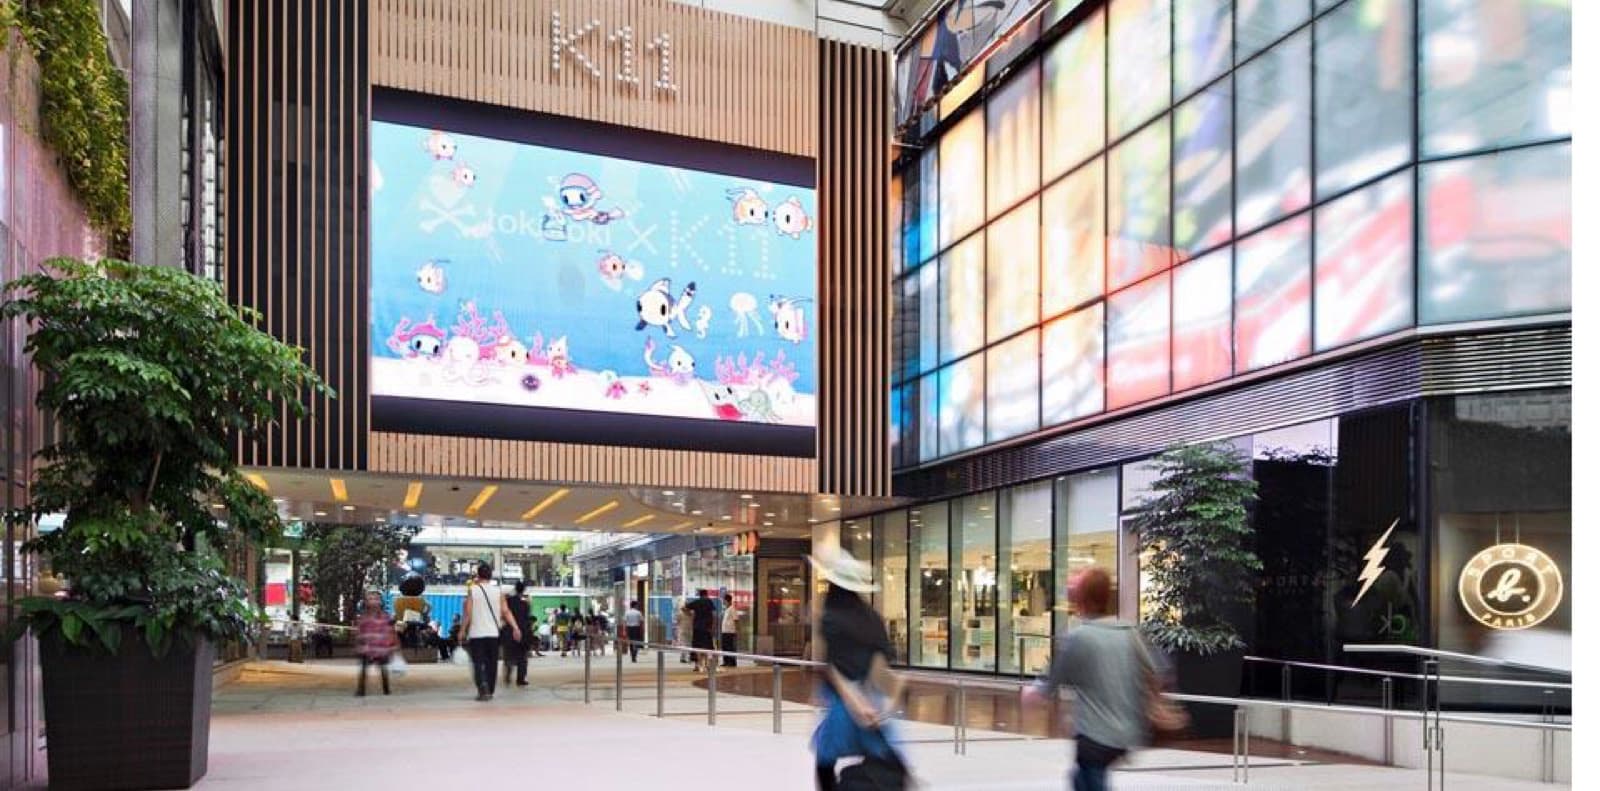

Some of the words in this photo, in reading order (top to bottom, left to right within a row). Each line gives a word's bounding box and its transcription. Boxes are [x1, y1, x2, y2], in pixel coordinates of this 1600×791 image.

[552, 10, 679, 91] K11
[487, 205, 611, 245] tokioki
[670, 210, 776, 281] K11
[1467, 548, 1554, 578] SPORT
[1482, 612, 1536, 628] PARIS
